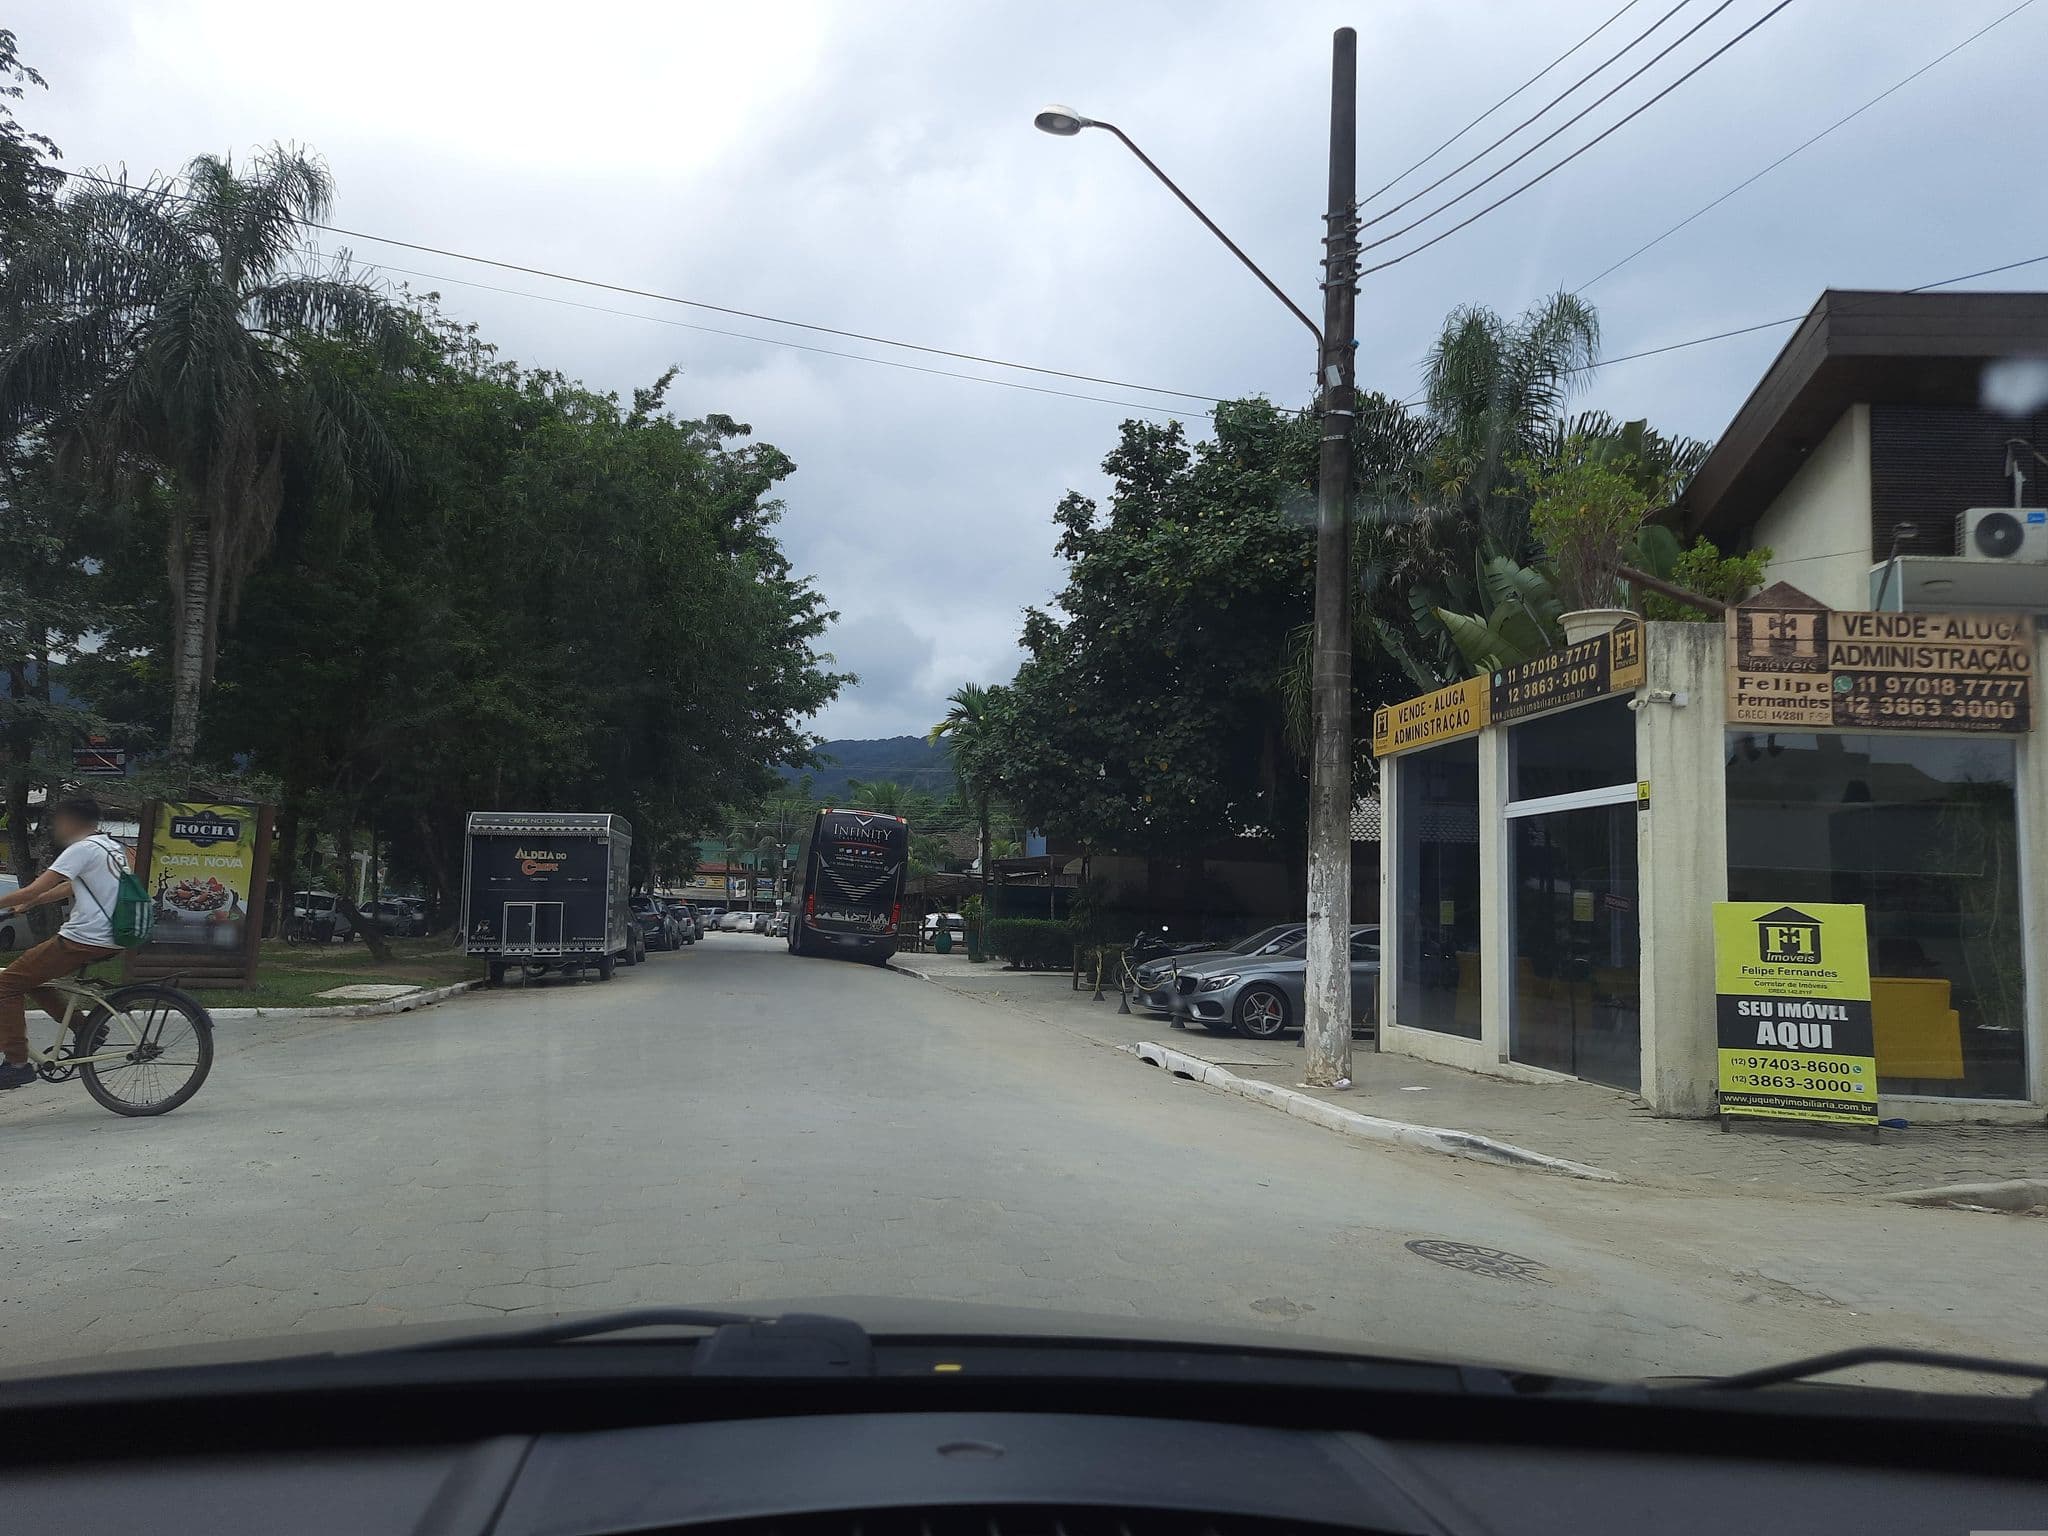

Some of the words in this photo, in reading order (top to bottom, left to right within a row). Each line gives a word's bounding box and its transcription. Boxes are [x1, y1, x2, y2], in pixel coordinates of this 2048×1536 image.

[1830, 643, 2031, 675] ADMINISTRAÇÃO
[1507, 668, 1516, 684] 11
[1736, 676, 1830, 694] Felipe
[1857, 675, 1878, 693] 11
[1508, 687, 1520, 704] 12
[1736, 692, 1831, 710] Fernandes
[1398, 701, 1427, 725] VENDE
[1434, 687, 1466, 713] ALUGA
[1845, 695, 1871, 715] 12
[1394, 707, 1471, 746] ADMINISTRAÇÃO
[174, 823, 235, 837] ROCHA
[833, 823, 892, 841] INFINITY
[160, 855, 200, 867] CARA
[204, 856, 244, 869] NOVA
[1741, 965, 1776, 977] Felipe
[1777, 966, 1839, 979] Fernandes
[1738, 1000, 1773, 1017] SEU
[1777, 1001, 1849, 1021] IMÓVEL
[1756, 1021, 1833, 1050] AQUI
[1731, 1058, 1746, 1066] (12)
[1747, 1057, 1851, 1075] 97403-8600
[1731, 1075, 1747, 1084] (12)
[1748, 1074, 1852, 1093] 3863-3000
[1723, 1093, 1873, 1113] www.juquehyimobiliaria.com.br
